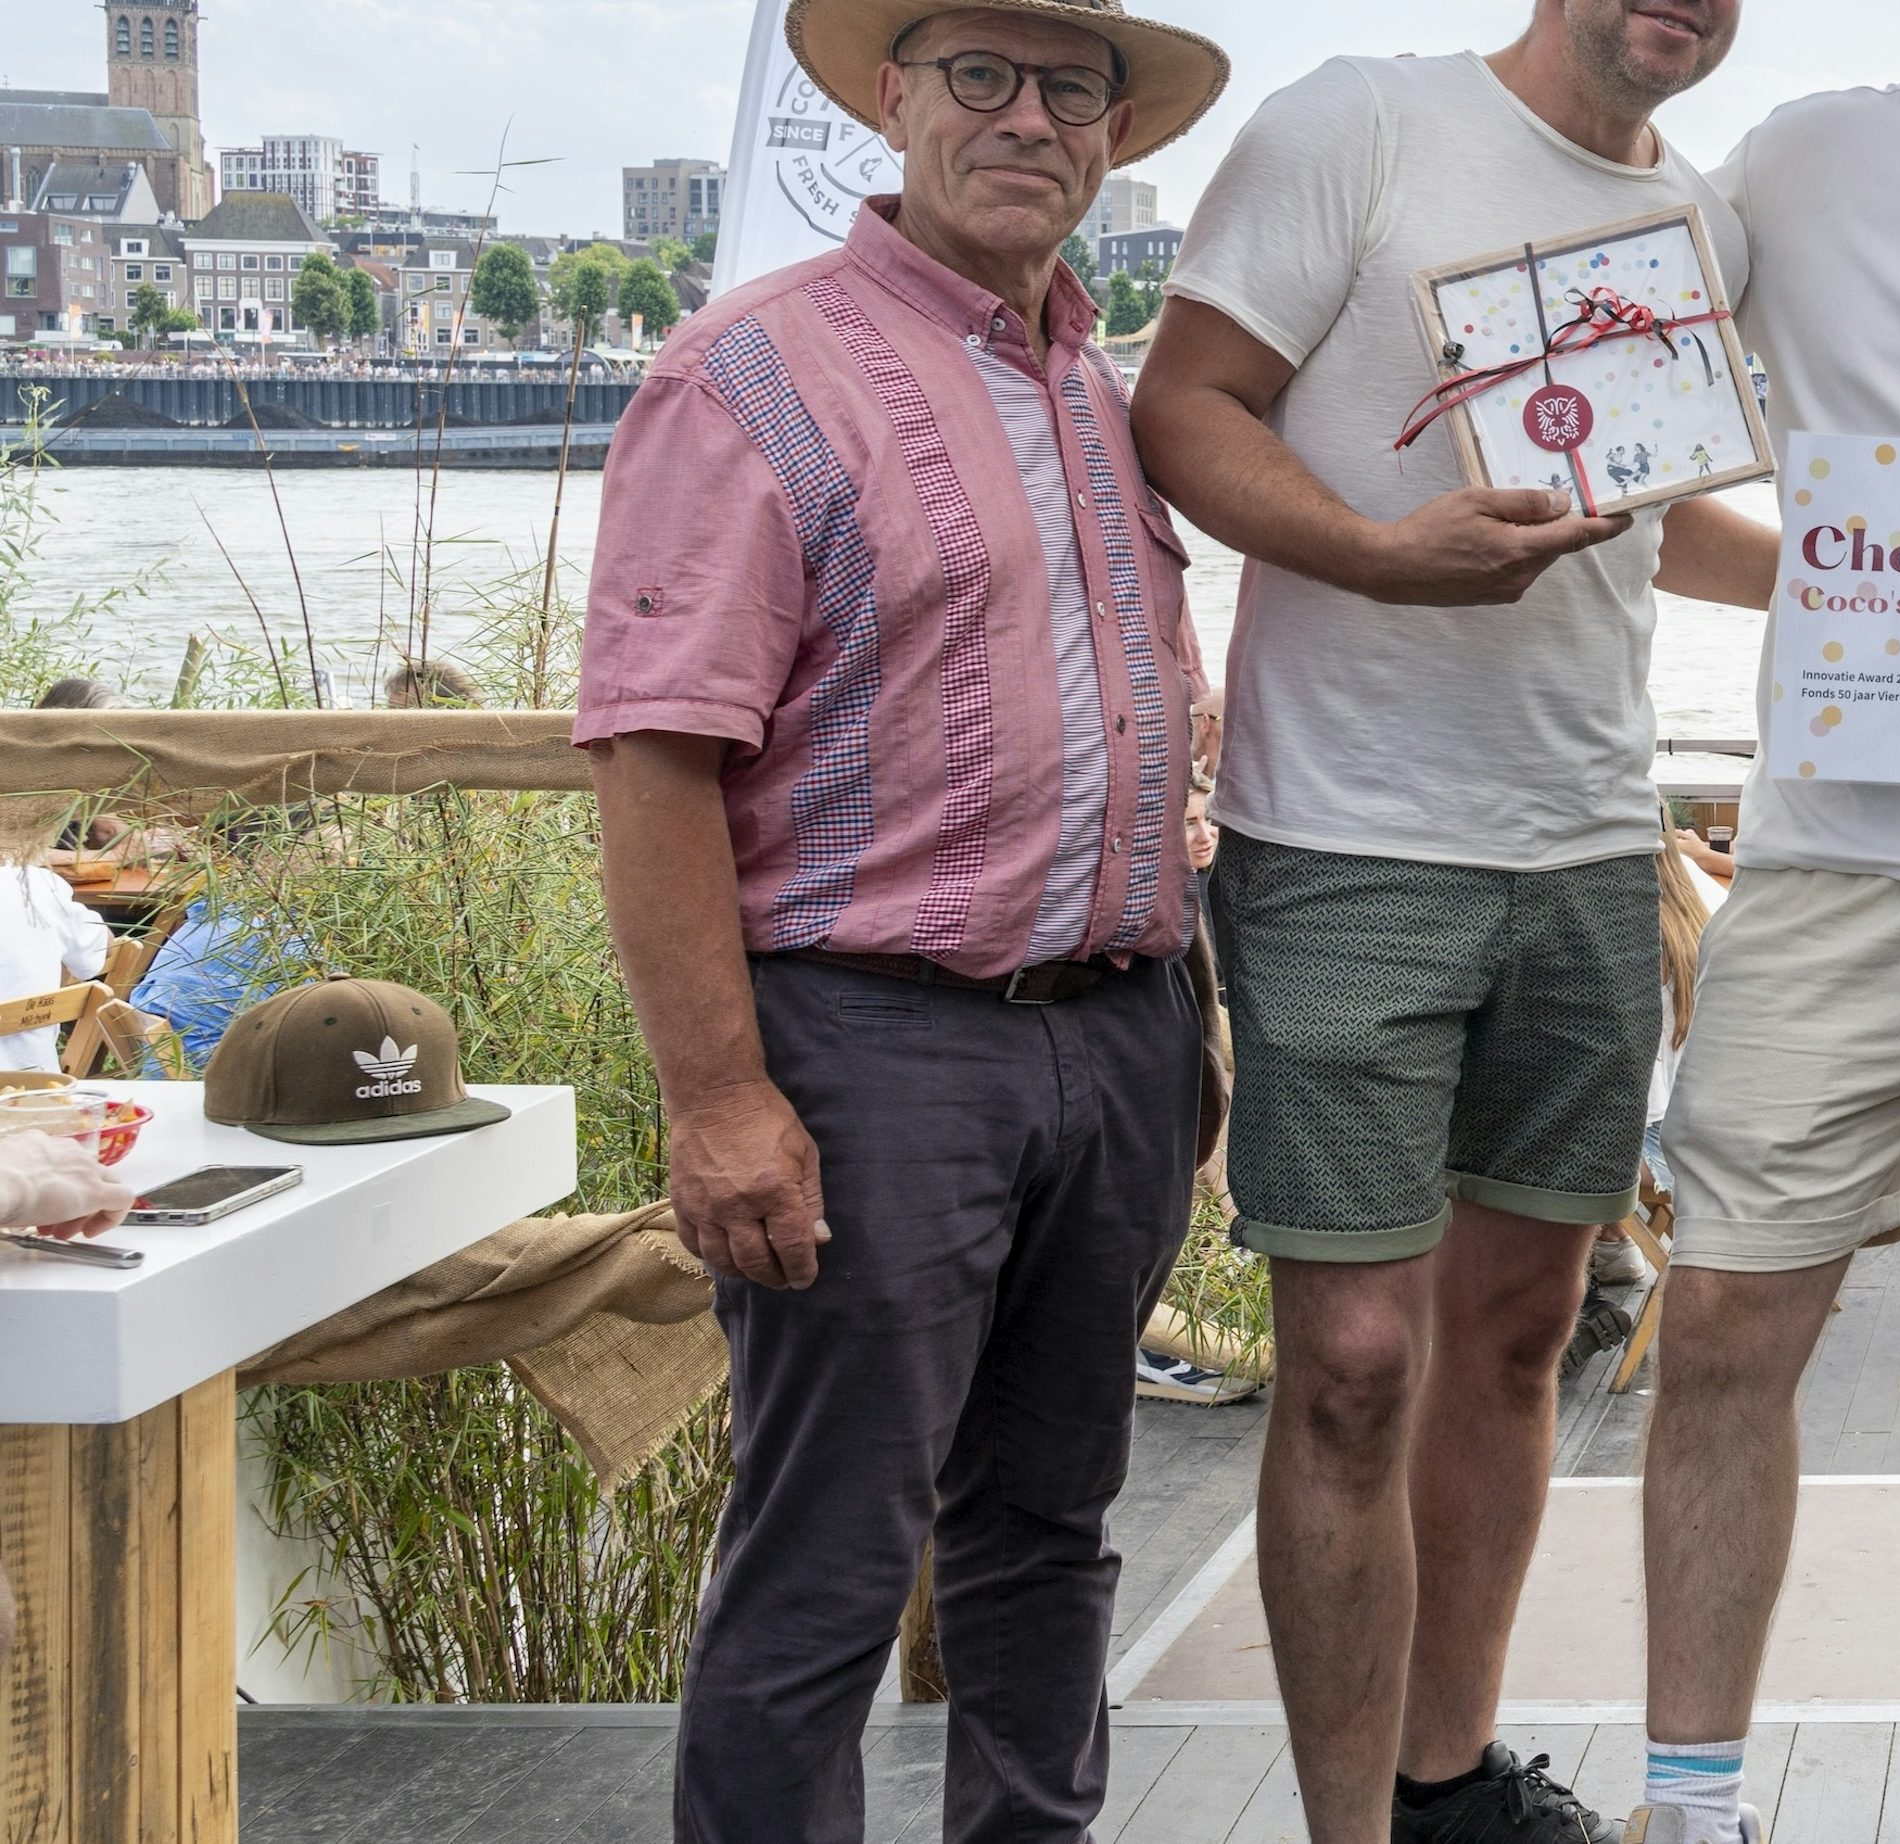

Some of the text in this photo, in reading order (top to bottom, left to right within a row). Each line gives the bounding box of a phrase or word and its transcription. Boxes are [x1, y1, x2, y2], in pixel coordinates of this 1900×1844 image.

[772, 125, 825, 143] SINCE
[792, 155, 840, 216] FRESH
[1802, 669, 1856, 682] Innovatie
[1857, 672, 1894, 684] Award
[1801, 687, 1836, 699] Fonds
[1838, 689, 1851, 700] 50
[1852, 690, 1876, 702] jaar
[355, 1079, 422, 1099] adidas
